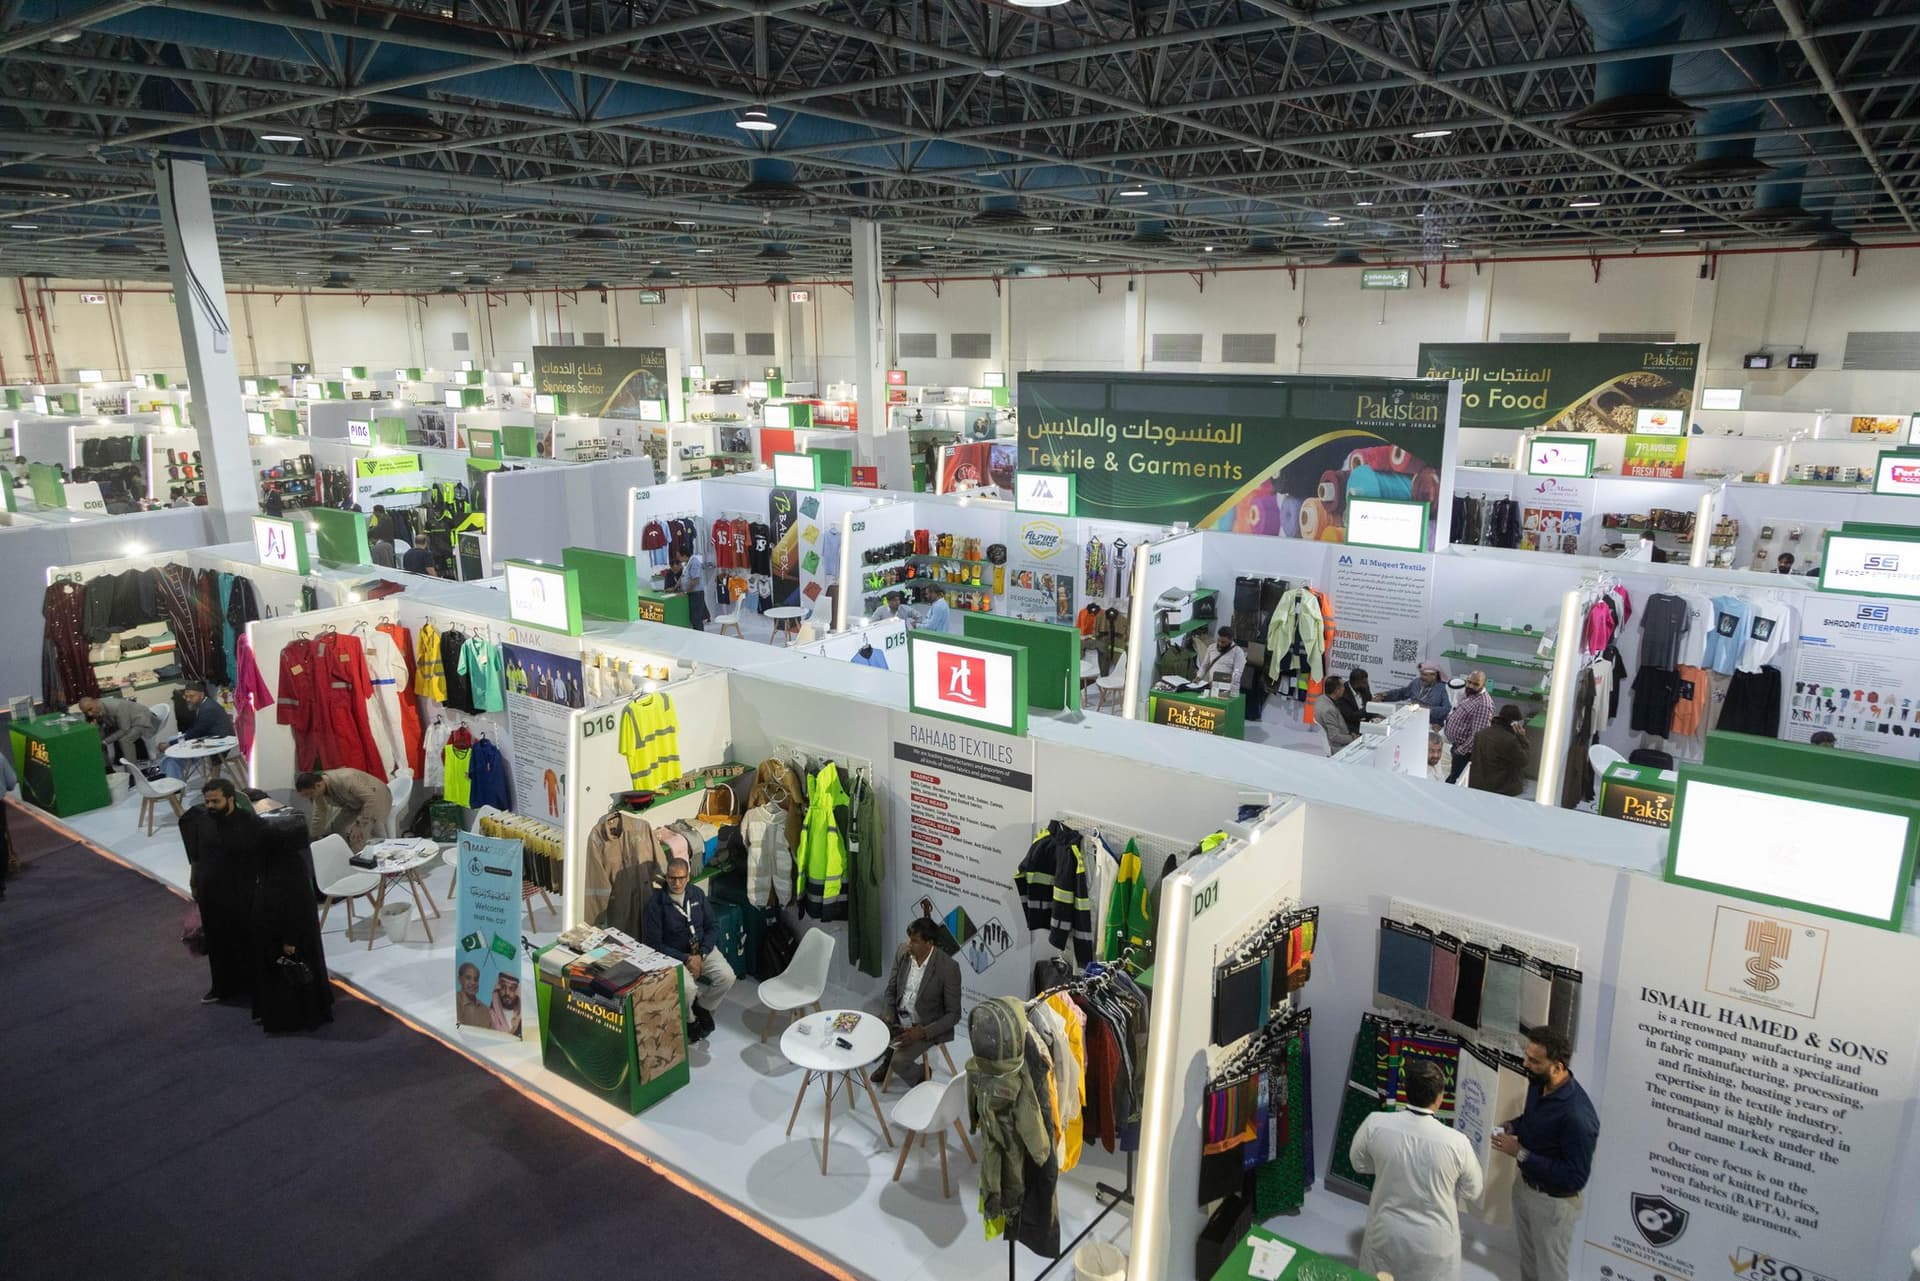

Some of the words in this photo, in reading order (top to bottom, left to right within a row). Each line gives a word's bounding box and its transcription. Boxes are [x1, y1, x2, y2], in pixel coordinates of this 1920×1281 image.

[542, 362, 575, 375] الخدمات
[1643, 352, 1693, 366] Pakistan
[578, 363, 602, 380] قطاع
[1483, 368, 1551, 383] المنتجات
[544, 380, 575, 393] Services
[578, 382, 604, 394] Sector
[1489, 388, 1548, 410] Food
[1356, 395, 1438, 420] Pakistan
[1027, 416, 1117, 443] والملابس
[1122, 419, 1242, 446] المنسوجات
[1634, 443, 1642, 456] 7
[1028, 447, 1096, 470] Textile
[1104, 451, 1119, 472] &
[1128, 452, 1243, 480] Garments
[1632, 466, 1654, 477] FRESH
[1657, 468, 1672, 478] TIME
[636, 491, 650, 500] C20
[717, 531, 727, 544] 15
[852, 522, 866, 532] C29
[1025, 531, 1058, 542] ALPINE
[1149, 553, 1162, 566] D14
[1370, 560, 1399, 569] Muqeet
[1400, 562, 1426, 571] Textile
[520, 631, 541, 646] MAK
[885, 632, 905, 649] D15
[1862, 623, 1919, 635] ENTERPRISES
[1331, 650, 1359, 662] PRODUCT
[1360, 655, 1383, 664] DESIGN
[1333, 640, 1369, 652] ELECTRONIC
[584, 715, 615, 737] D16
[1168, 707, 1215, 730] Pakistan
[910, 725, 956, 751] RAHAAB
[959, 735, 1013, 765] TEXTILES
[1194, 881, 1218, 917] D01
[1640, 987, 1712, 1018] ISMAIL
[1718, 1007, 1798, 1040] HAMED
[1805, 1032, 1820, 1048] &
[1828, 1037, 1888, 1066] SONS
[1658, 1010, 1667, 1021] is
[1670, 1016, 1677, 1025] a
[1681, 1019, 1737, 1041] renowned
[1741, 1035, 1833, 1070] manufacturing
[1836, 1062, 1861, 1075] and
[1638, 1022, 1692, 1046] exporting
[1695, 1039, 1748, 1062] company
[1752, 1054, 1778, 1068] with
[1782, 1063, 1789, 1072] a
[1793, 1066, 1879, 1097] specialization
[1645, 1037, 1657, 1048] in
[1660, 1041, 1694, 1059] fabric
[1697, 1053, 1789, 1088] manufacturing,
[1793, 1082, 1864, 1110] processing,
[1658, 1058, 1679, 1070] and
[1683, 1063, 1736, 1088] finishing,
[1741, 1080, 1792, 1105] boasting
[1794, 1099, 1828, 1114] years
[1832, 1109, 1847, 1120] of
[1655, 1072, 1706, 1093] expertise
[1709, 1086, 1720, 1098] in
[1724, 1091, 1743, 1104] the
[1746, 1098, 1783, 1116] textile
[1786, 1109, 1843, 1135] industry.
[1645, 1081, 1667, 1097] The
[1670, 1091, 1721, 1114] company
[1724, 1106, 1734, 1117] is
[1737, 1110, 1774, 1131] highly
[1779, 1124, 1835, 1147] regarded
[1838, 1140, 1851, 1153] in
[1651, 1097, 1724, 1129] international
[1727, 1123, 1775, 1145] markets
[1779, 1140, 1816, 1157] under
[1819, 1151, 1840, 1165] the
[1667, 1117, 1701, 1136] brand
[1704, 1131, 1736, 1148] name
[1740, 1141, 1769, 1159] Lock
[1773, 1151, 1815, 1173] Brand.
[1668, 1141, 1692, 1156] Our
[1694, 1151, 1719, 1166] core
[1722, 1159, 1752, 1178] focus
[1756, 1169, 1766, 1181] is
[1769, 1176, 1784, 1188] on
[1788, 1181, 1808, 1195] the
[1649, 1151, 1710, 1178] production
[1713, 1172, 1726, 1183] of
[1728, 1176, 1770, 1198] knitted
[1773, 1191, 1820, 1215] fabrics,
[1651, 1165, 1685, 1184] woven
[1688, 1177, 1728, 1198] fabrics
[1731, 1191, 1790, 1221] (BAFTA),
[1794, 1215, 1818, 1229] and
[1661, 1183, 1701, 1204] various
[1704, 1199, 1739, 1217] textile
[1742, 1213, 1802, 1239] garments.
[1614, 1235, 1673, 1261] INTERNATIONAL
[1751, 1253, 1803, 1281] ISO
